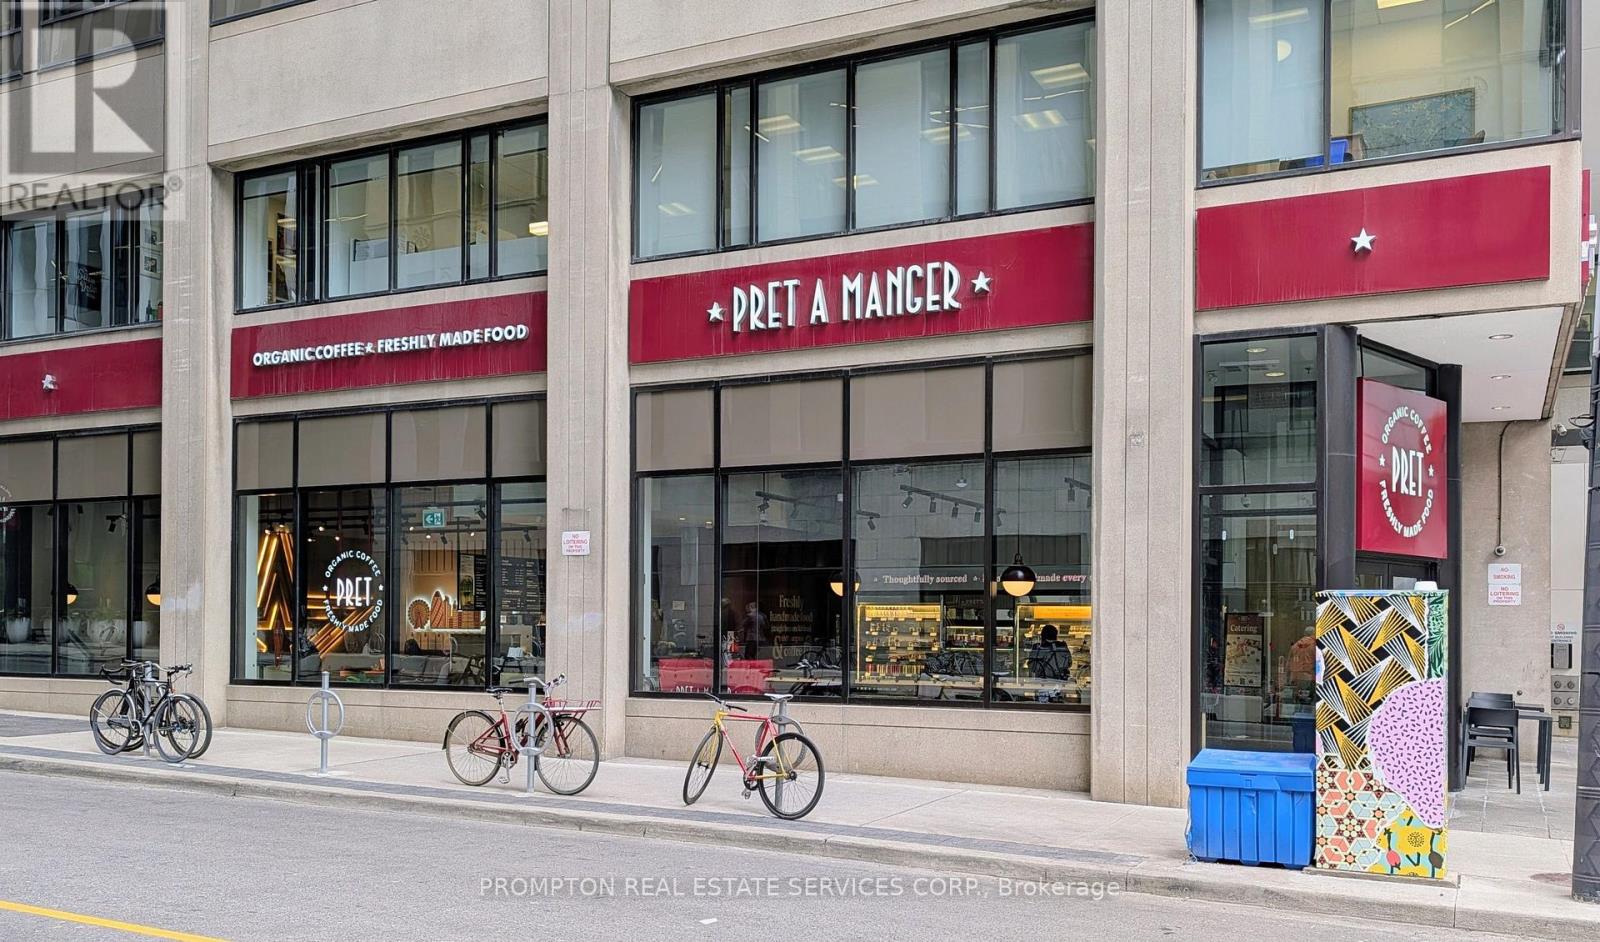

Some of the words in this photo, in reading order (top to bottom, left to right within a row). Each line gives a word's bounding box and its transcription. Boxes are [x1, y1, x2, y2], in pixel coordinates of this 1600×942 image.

[733, 279, 800, 332] PRET
[810, 278, 829, 325] A
[842, 261, 962, 321] MANGER
[253, 348, 315, 367] ORGANIC
[315, 343, 365, 360] COFFEE
[377, 333, 437, 353] FRESHLY
[439, 328, 483, 347] MADE
[484, 324, 529, 343] FOOD
[1381, 406, 1409, 444] ORGANIC
[1409, 409, 1432, 455] COFFEE
[1392, 446, 1424, 497] PRET
[1379, 480, 1403, 534] FRESHLY
[1403, 519, 1423, 538] MADE
[1421, 488, 1434, 525] FOOD
[324, 550, 354, 578] ORGANIC
[355, 550, 381, 577] COFFEE
[882, 574, 934, 585] Thoughtfully
[935, 574, 968, 583] sourced
[1062, 575, 1087, 583] every
[336, 576, 373, 607] PRET
[323, 599, 347, 632] FRESHLY
[348, 620, 369, 633] MADE
[368, 599, 383, 623] FOOD
[1230, 624, 1258, 634] Catering
